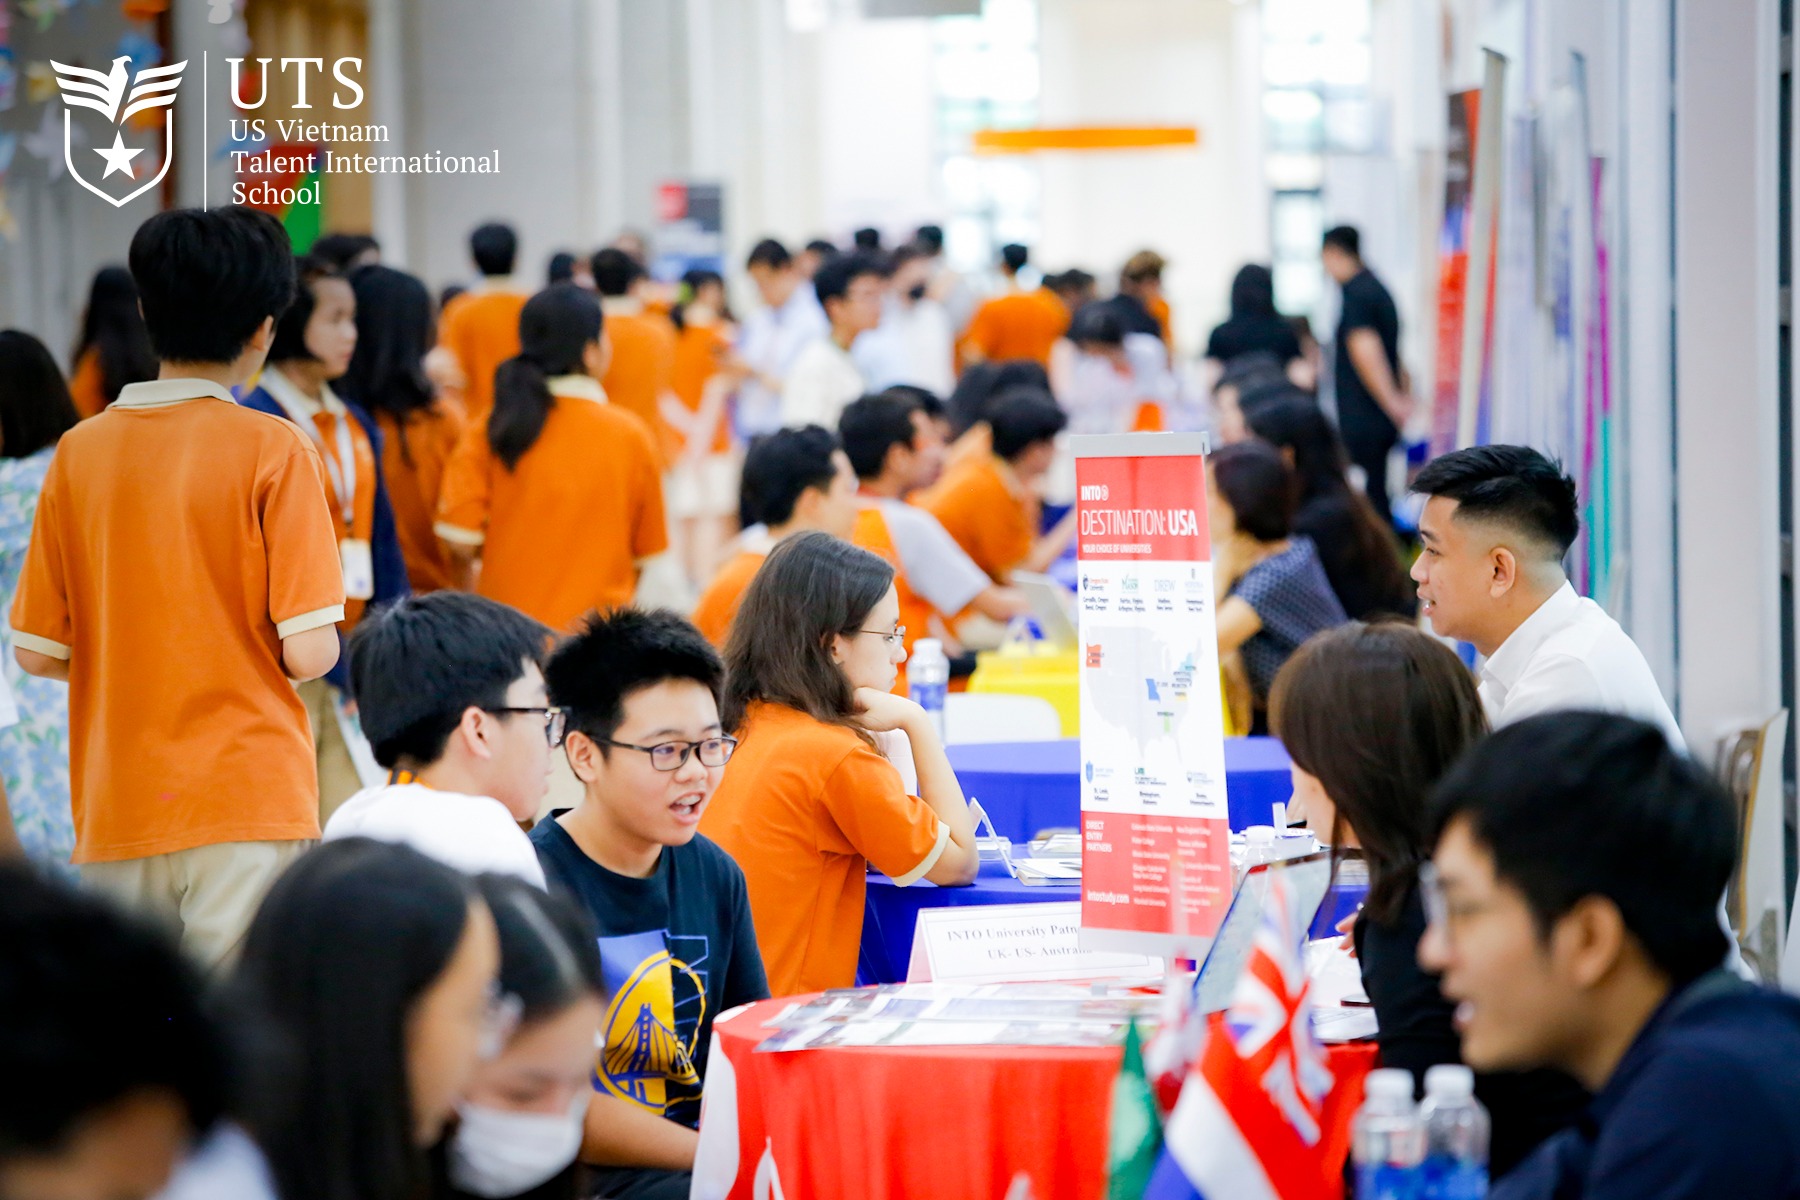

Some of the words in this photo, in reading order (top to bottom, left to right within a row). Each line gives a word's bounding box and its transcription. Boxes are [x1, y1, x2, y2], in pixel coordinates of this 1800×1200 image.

[1081, 485, 1101, 501] INTO
[1081, 509, 1167, 536] DESTINATION:
[1167, 509, 1199, 537] USA
[1082, 543, 1096, 553] YOUR
[1096, 543, 1113, 553] CHOICE
[1113, 543, 1120, 553] OF
[1120, 543, 1152, 554] UNIVERSITIES
[1086, 820, 1105, 830] DIRECT
[1086, 831, 1103, 841] ENTRY
[1086, 841, 1113, 853] PARTNERS
[947, 929, 983, 942] INTO
[986, 925, 1047, 941] University
[1050, 924, 1078, 935] Patn
